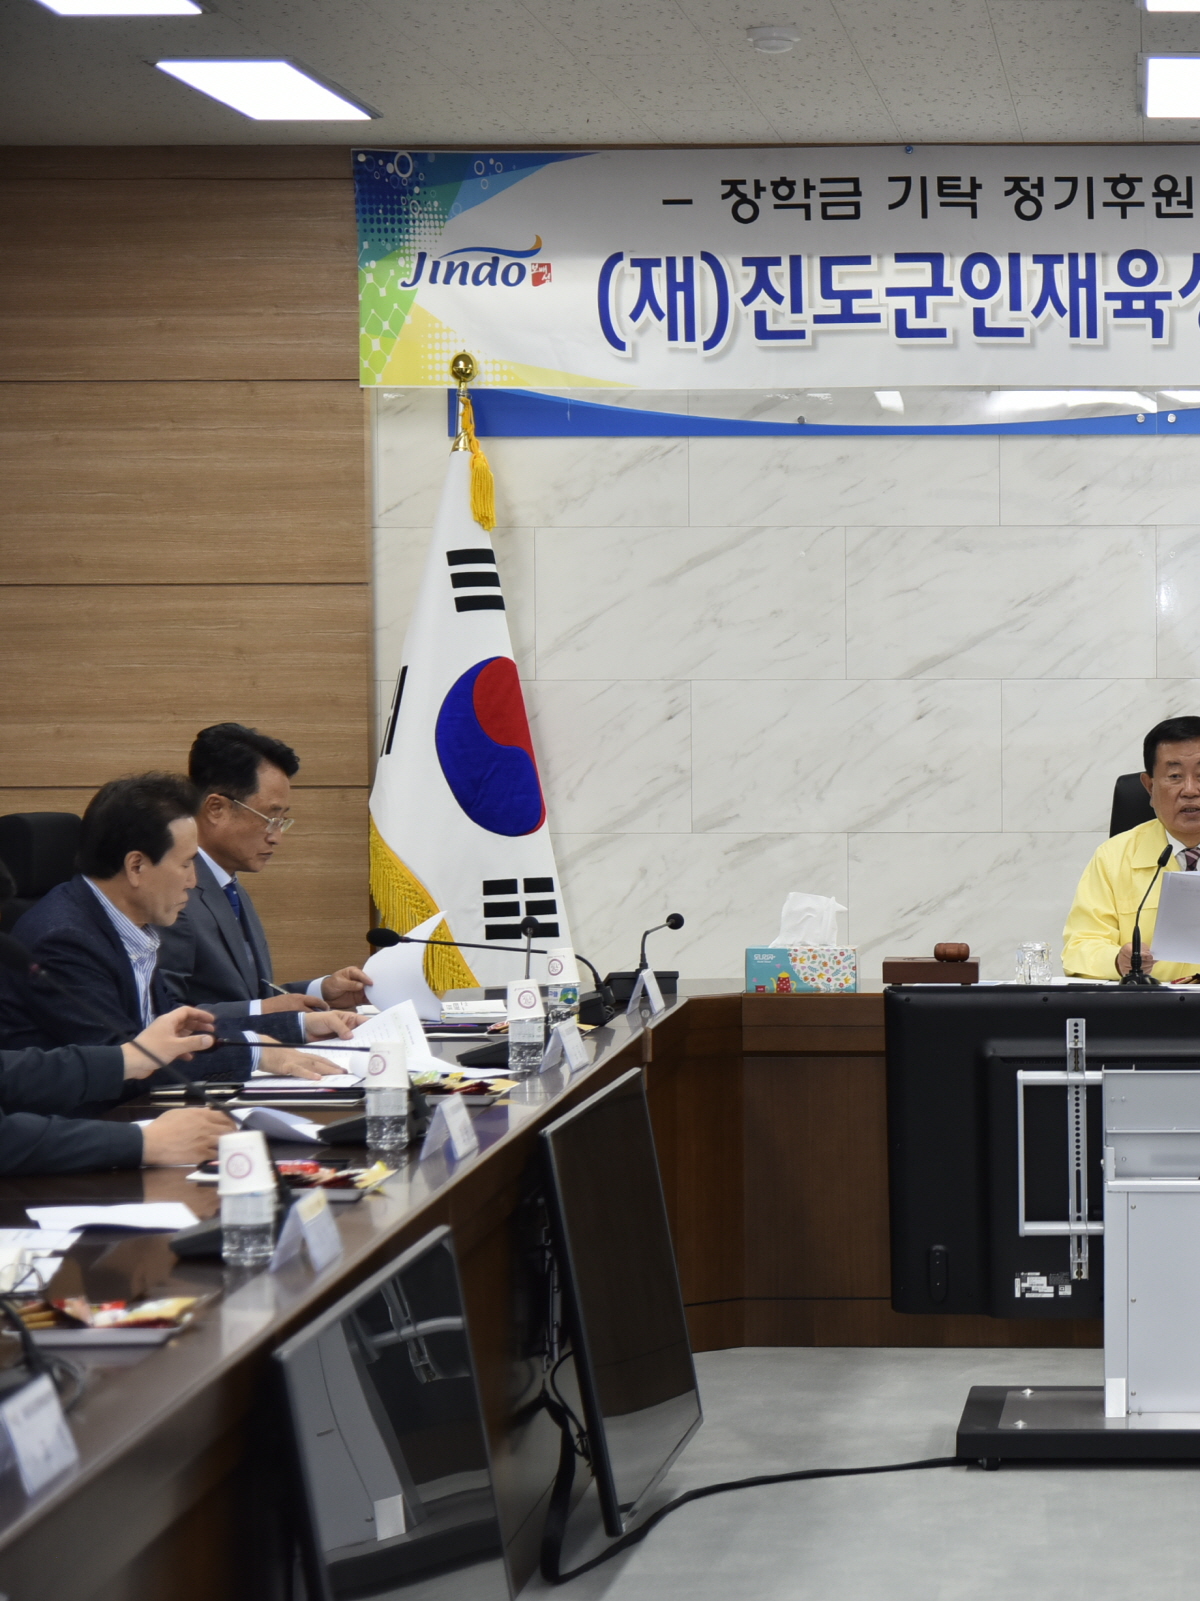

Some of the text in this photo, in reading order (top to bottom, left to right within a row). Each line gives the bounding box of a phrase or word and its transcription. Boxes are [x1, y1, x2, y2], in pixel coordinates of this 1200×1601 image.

[720, 176, 864, 226] 장학금
[887, 175, 984, 221] 기탁
[1003, 173, 1195, 223] 정기후원
[400, 251, 527, 288] Jindo
